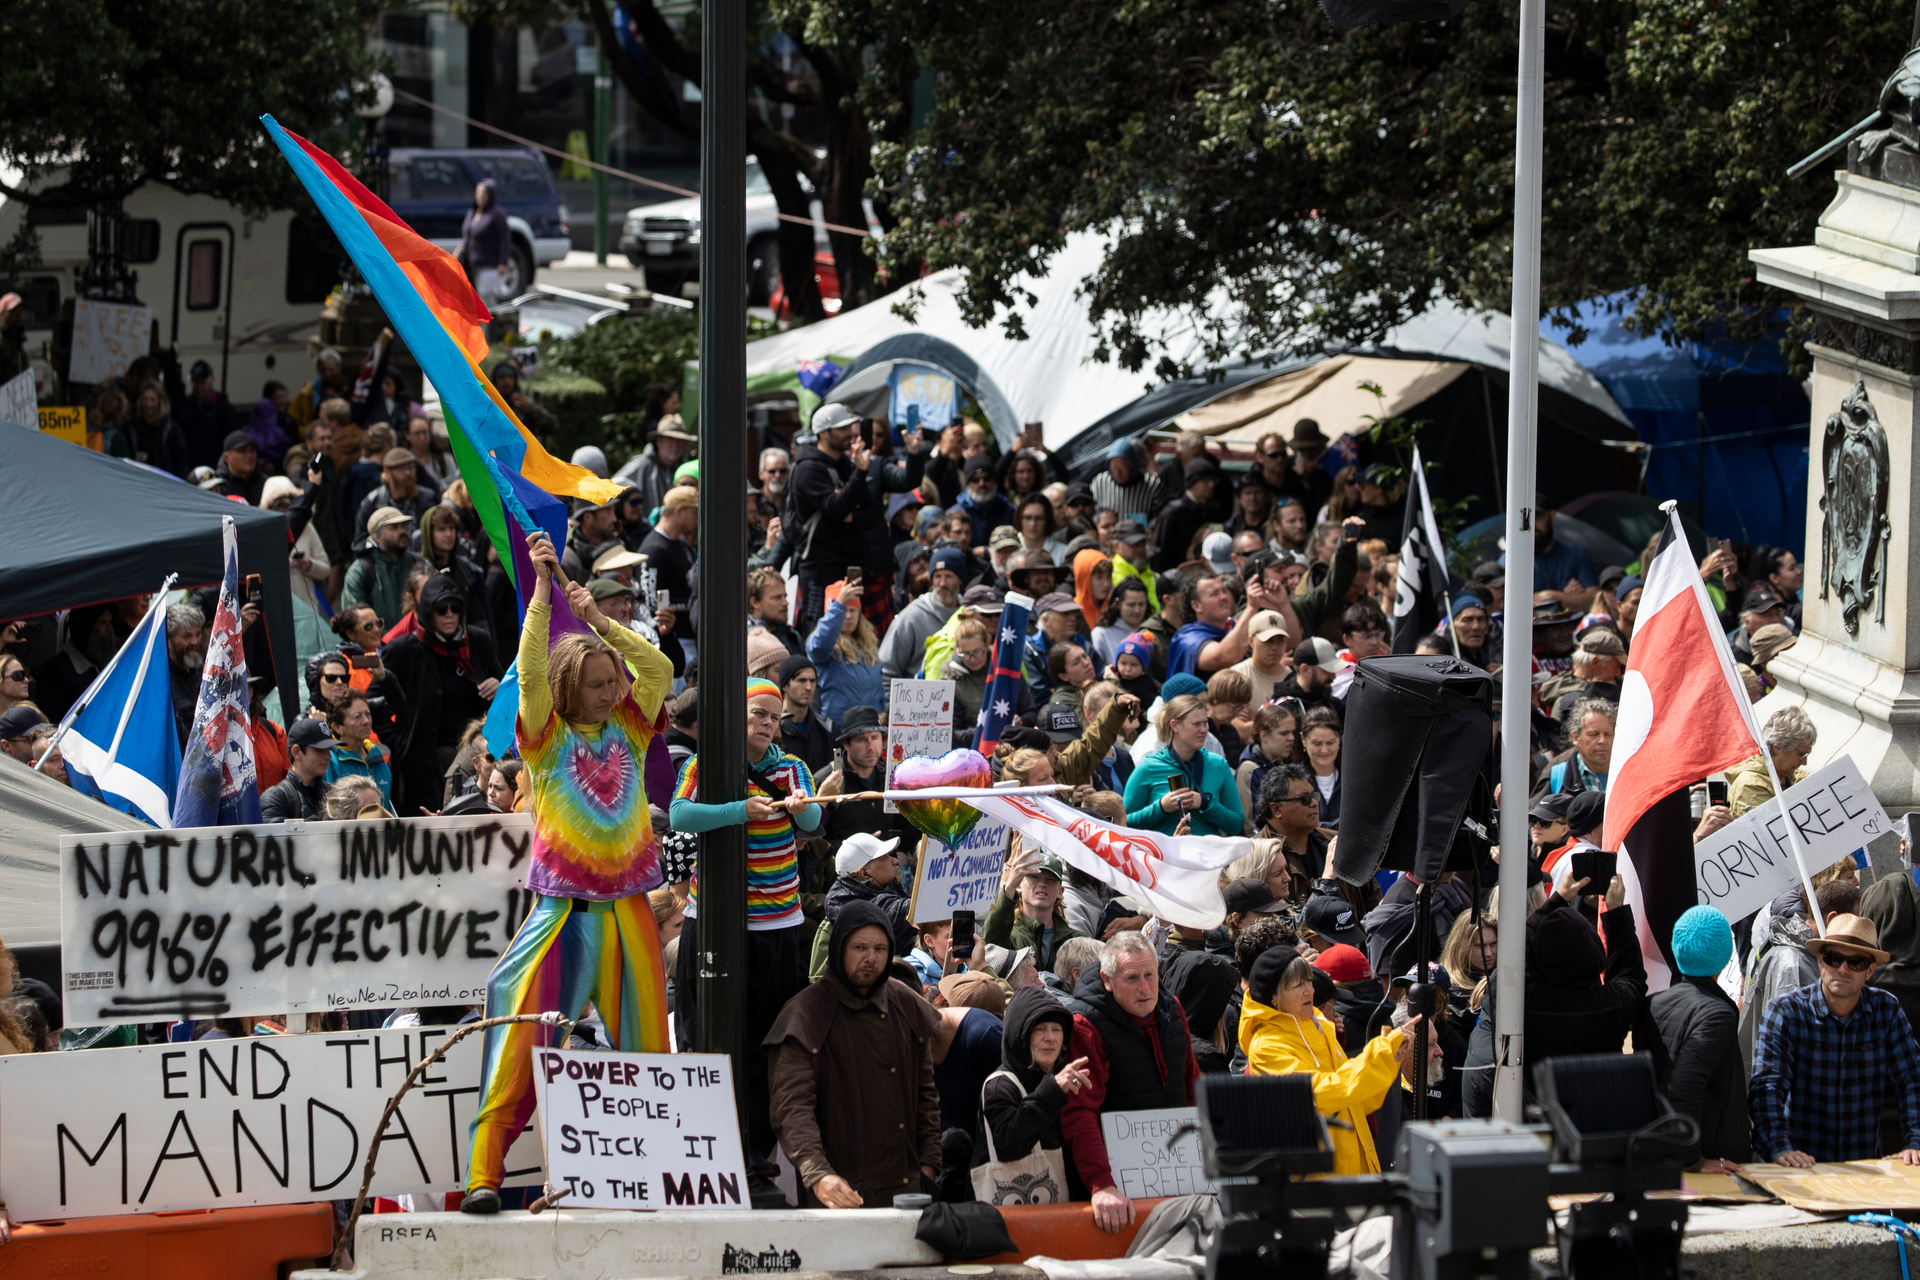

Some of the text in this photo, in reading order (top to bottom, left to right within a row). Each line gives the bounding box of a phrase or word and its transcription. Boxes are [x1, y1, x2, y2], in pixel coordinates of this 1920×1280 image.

[894, 683, 945, 708] This is just
[894, 708, 905, 722] the
[891, 728, 951, 744] We will NEVER
[1765, 775, 1867, 859] FREE
[75, 819, 530, 900] NATURAL IMMUNITY
[927, 849, 1006, 881] NOT A COMMUNIST
[161, 1029, 447, 1100] END THE
[539, 1052, 721, 1091] POWER TO THE
[560, 1124, 717, 1160] STICK IT
[1141, 1141, 1188, 1166] SAME
[564, 1172, 742, 1206] TO THE MAN
[633, 1246, 702, 1263] RHINO
[735, 1255, 792, 1268] FOR HIRE
